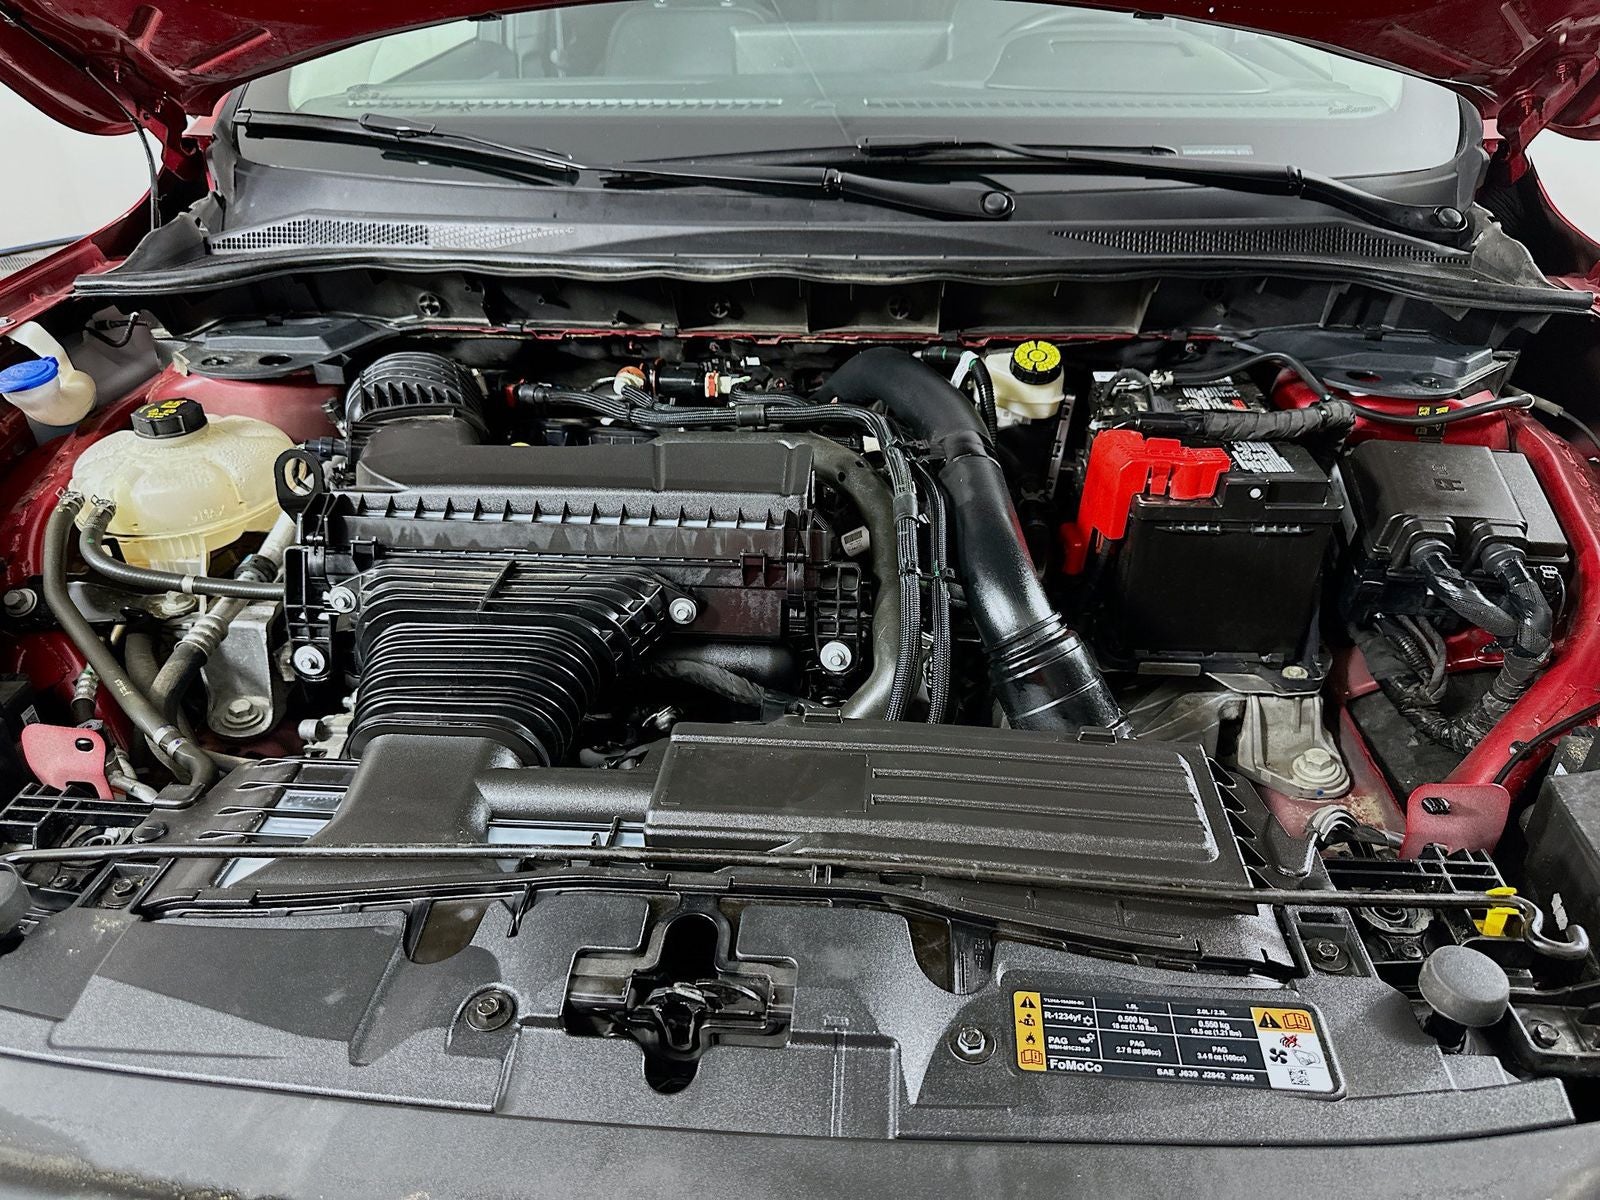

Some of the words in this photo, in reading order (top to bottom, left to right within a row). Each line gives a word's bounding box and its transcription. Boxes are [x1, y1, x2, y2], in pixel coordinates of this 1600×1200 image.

[1044, 1010, 1082, 1023] R-1234yf
[1138, 1016, 1149, 1026] kg
[1219, 1020, 1230, 1031] kg
[1047, 1035, 1069, 1045] PAG
[1129, 1039, 1146, 1048] PAG
[1211, 1045, 1229, 1054] PAG
[1049, 1058, 1103, 1073] FoMoCo
[1156, 1068, 1176, 1077] SAE
